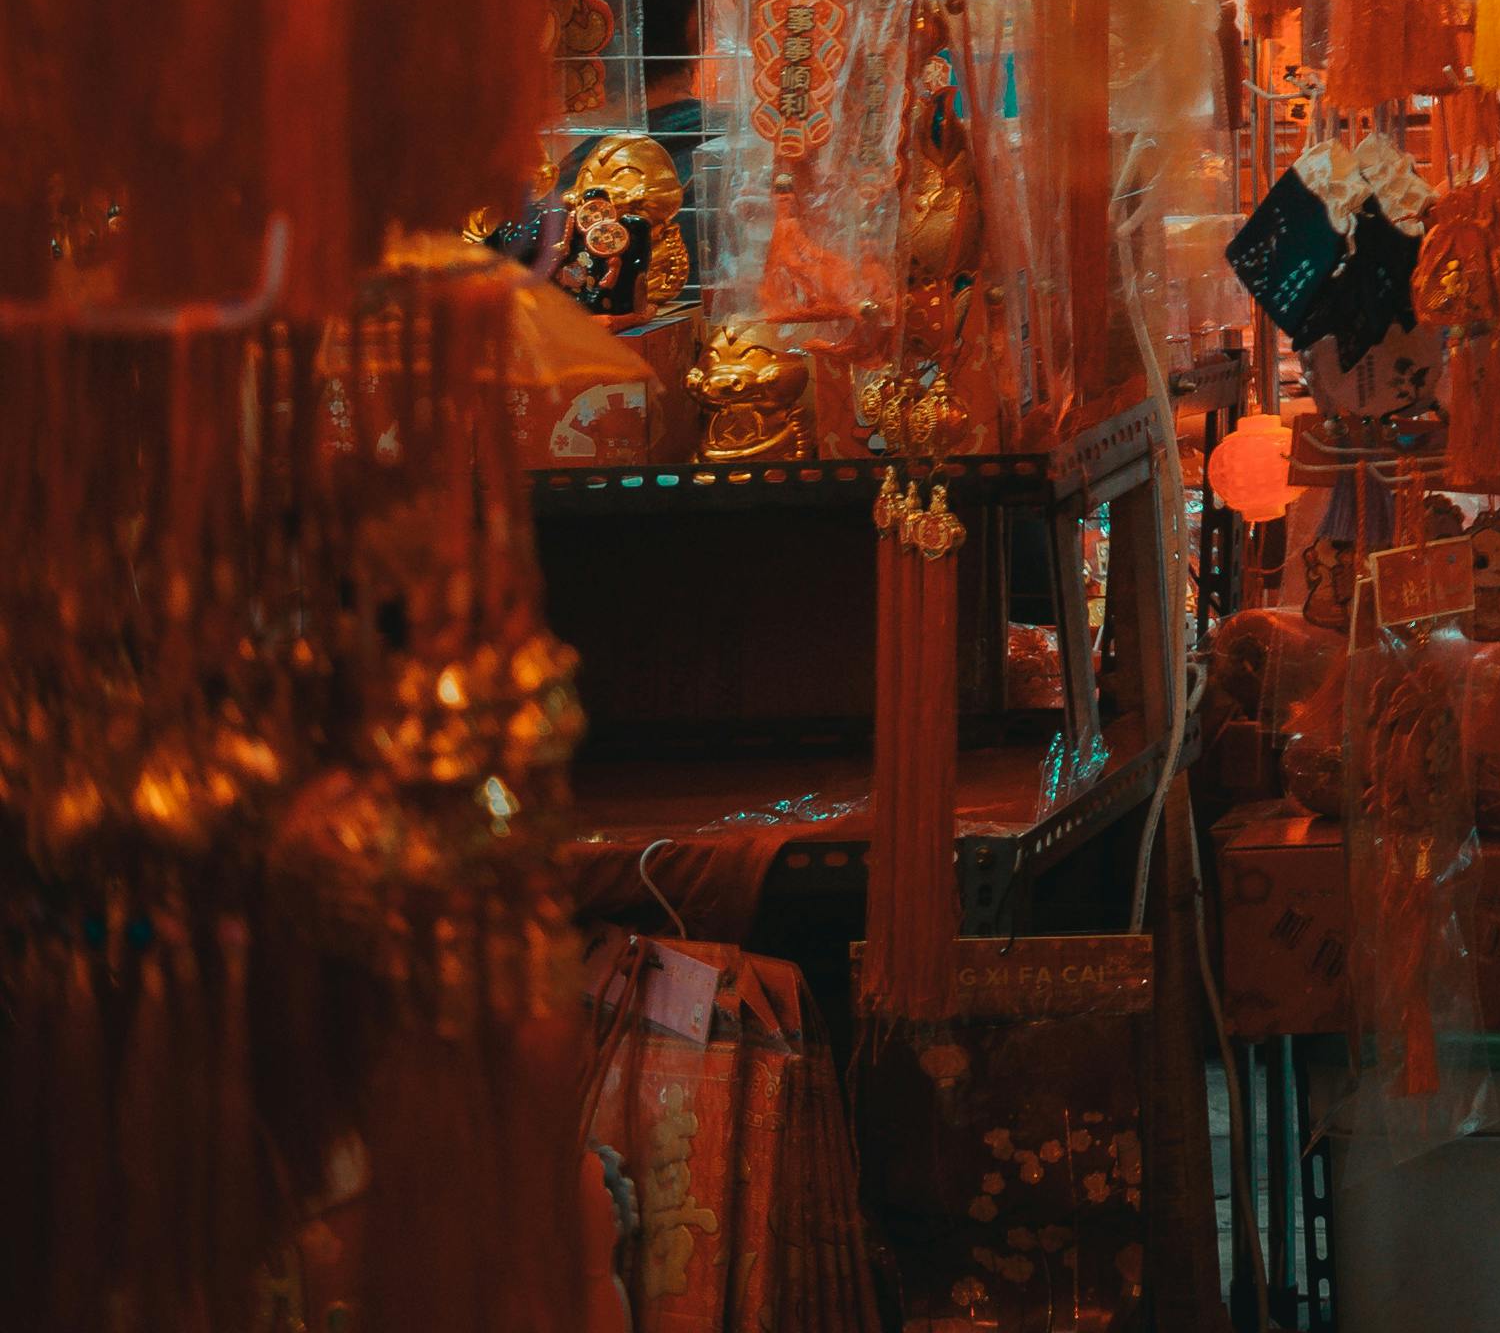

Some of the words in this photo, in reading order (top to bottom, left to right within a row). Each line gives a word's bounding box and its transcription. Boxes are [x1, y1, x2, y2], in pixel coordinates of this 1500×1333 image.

[781, 4, 812, 120] 事事順利
[1018, 965, 1053, 986] FA
[1061, 964, 1108, 985] CAI
